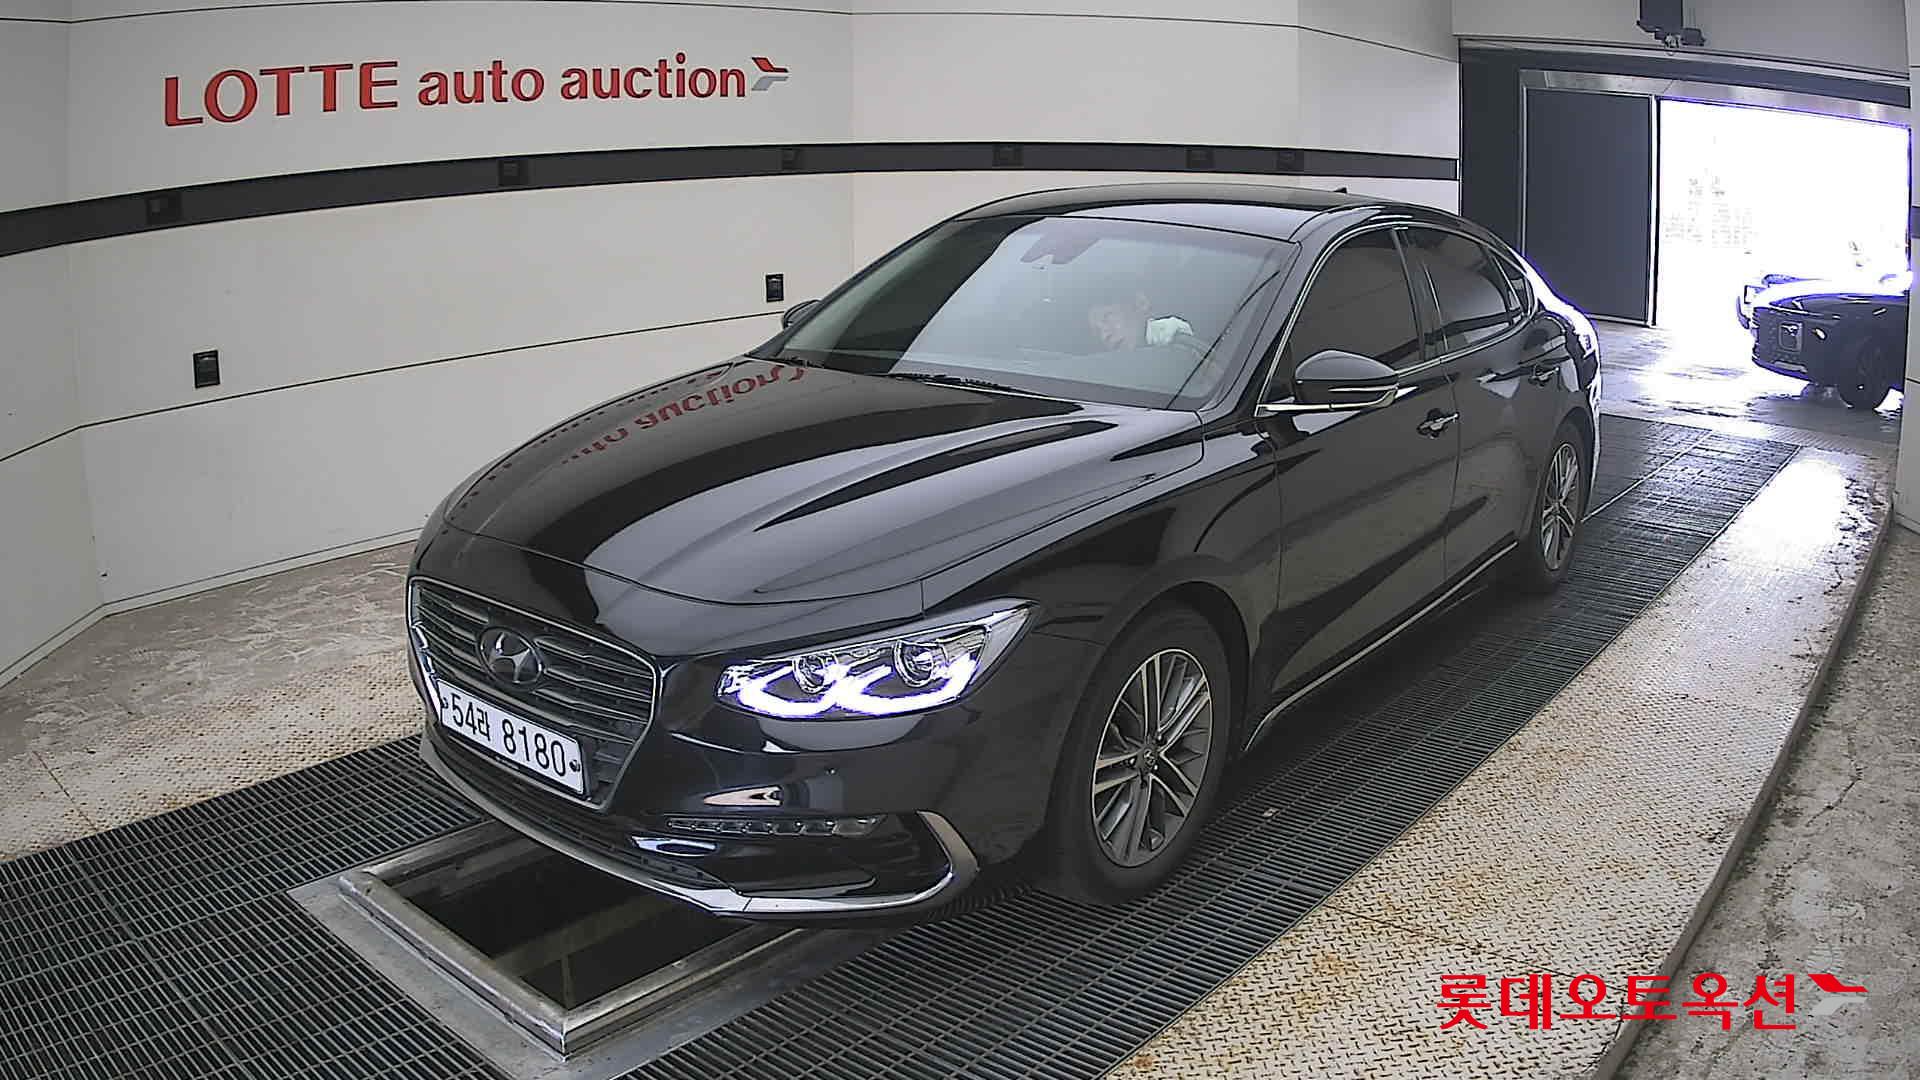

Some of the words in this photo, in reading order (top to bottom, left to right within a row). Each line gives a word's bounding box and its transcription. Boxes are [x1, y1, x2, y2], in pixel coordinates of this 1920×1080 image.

[163, 60, 399, 127] LOTTE
[416, 59, 545, 107] auto
[560, 52, 747, 101] auction
[450, 692, 491, 742] 54라
[502, 718, 566, 777] 8180
